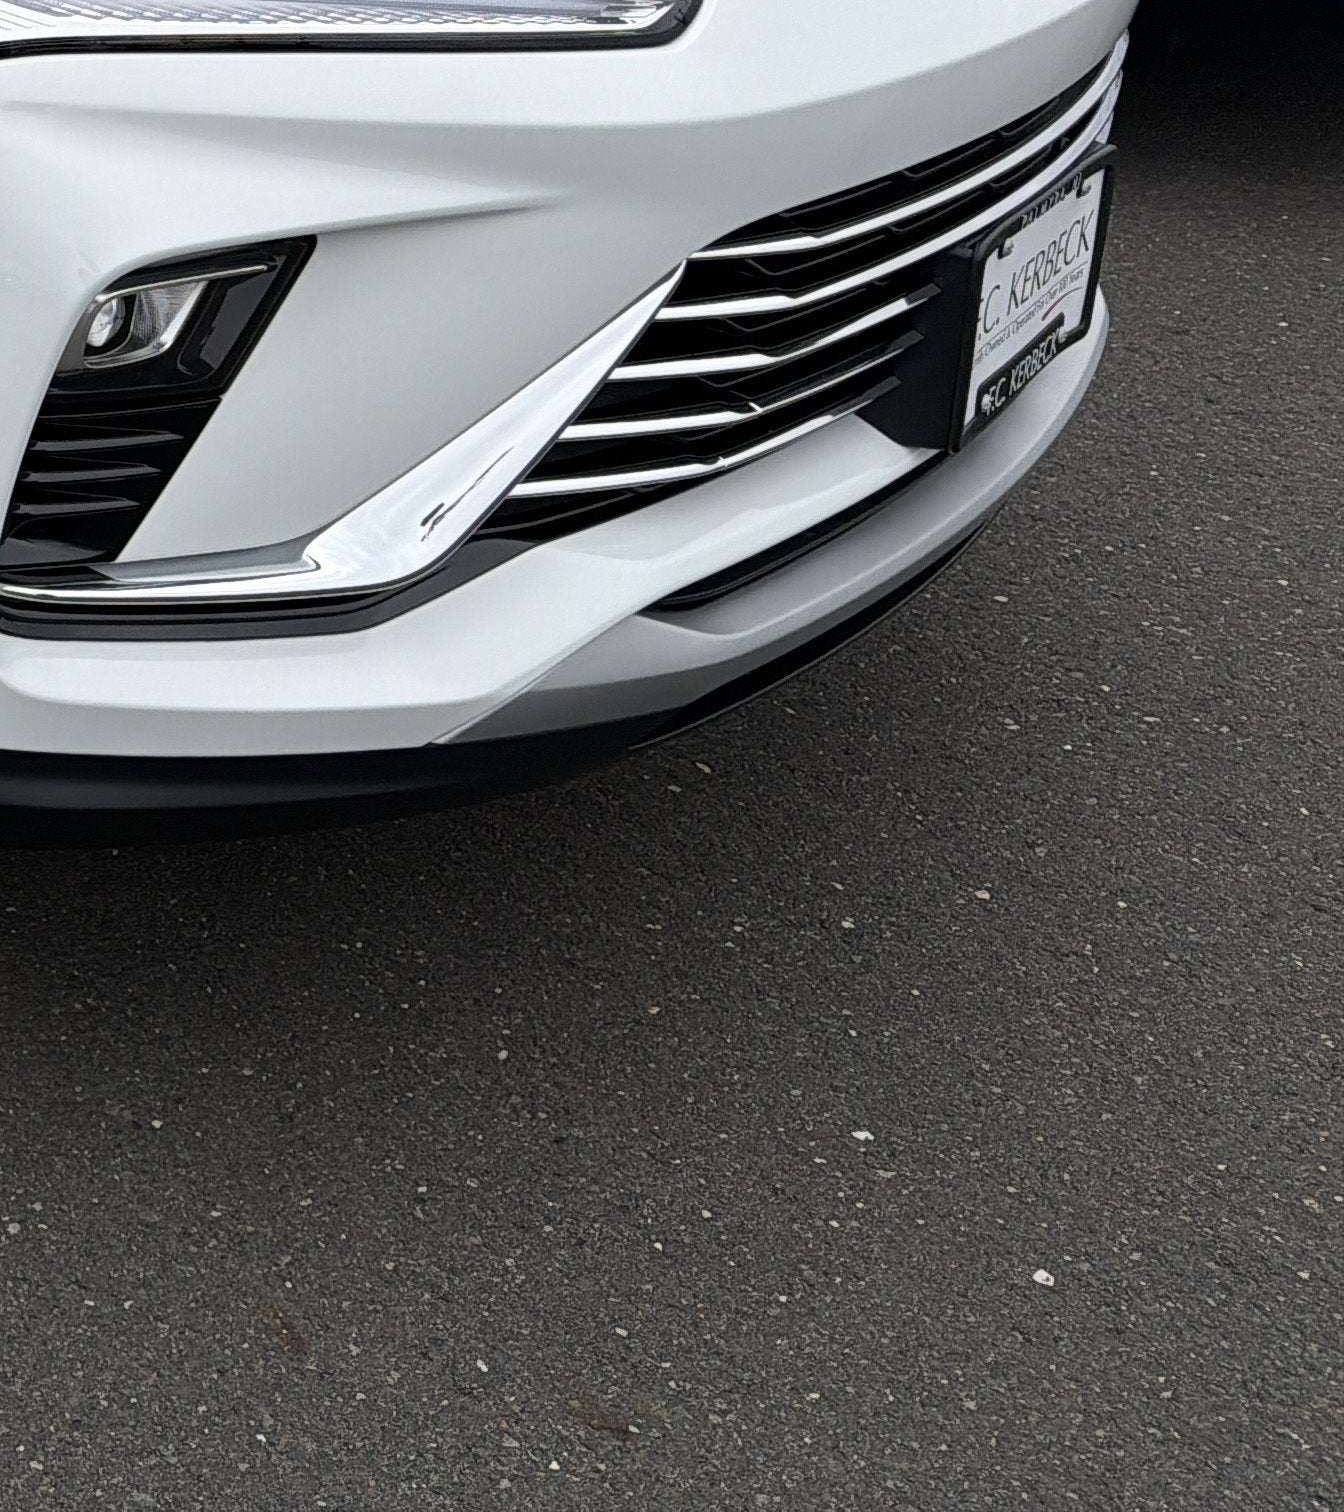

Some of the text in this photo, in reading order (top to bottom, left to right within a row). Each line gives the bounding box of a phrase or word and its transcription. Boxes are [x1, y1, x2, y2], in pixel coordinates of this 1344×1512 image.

[976, 208, 1095, 341] .C. KERBECK
[1008, 328, 1061, 396] KERBECK
